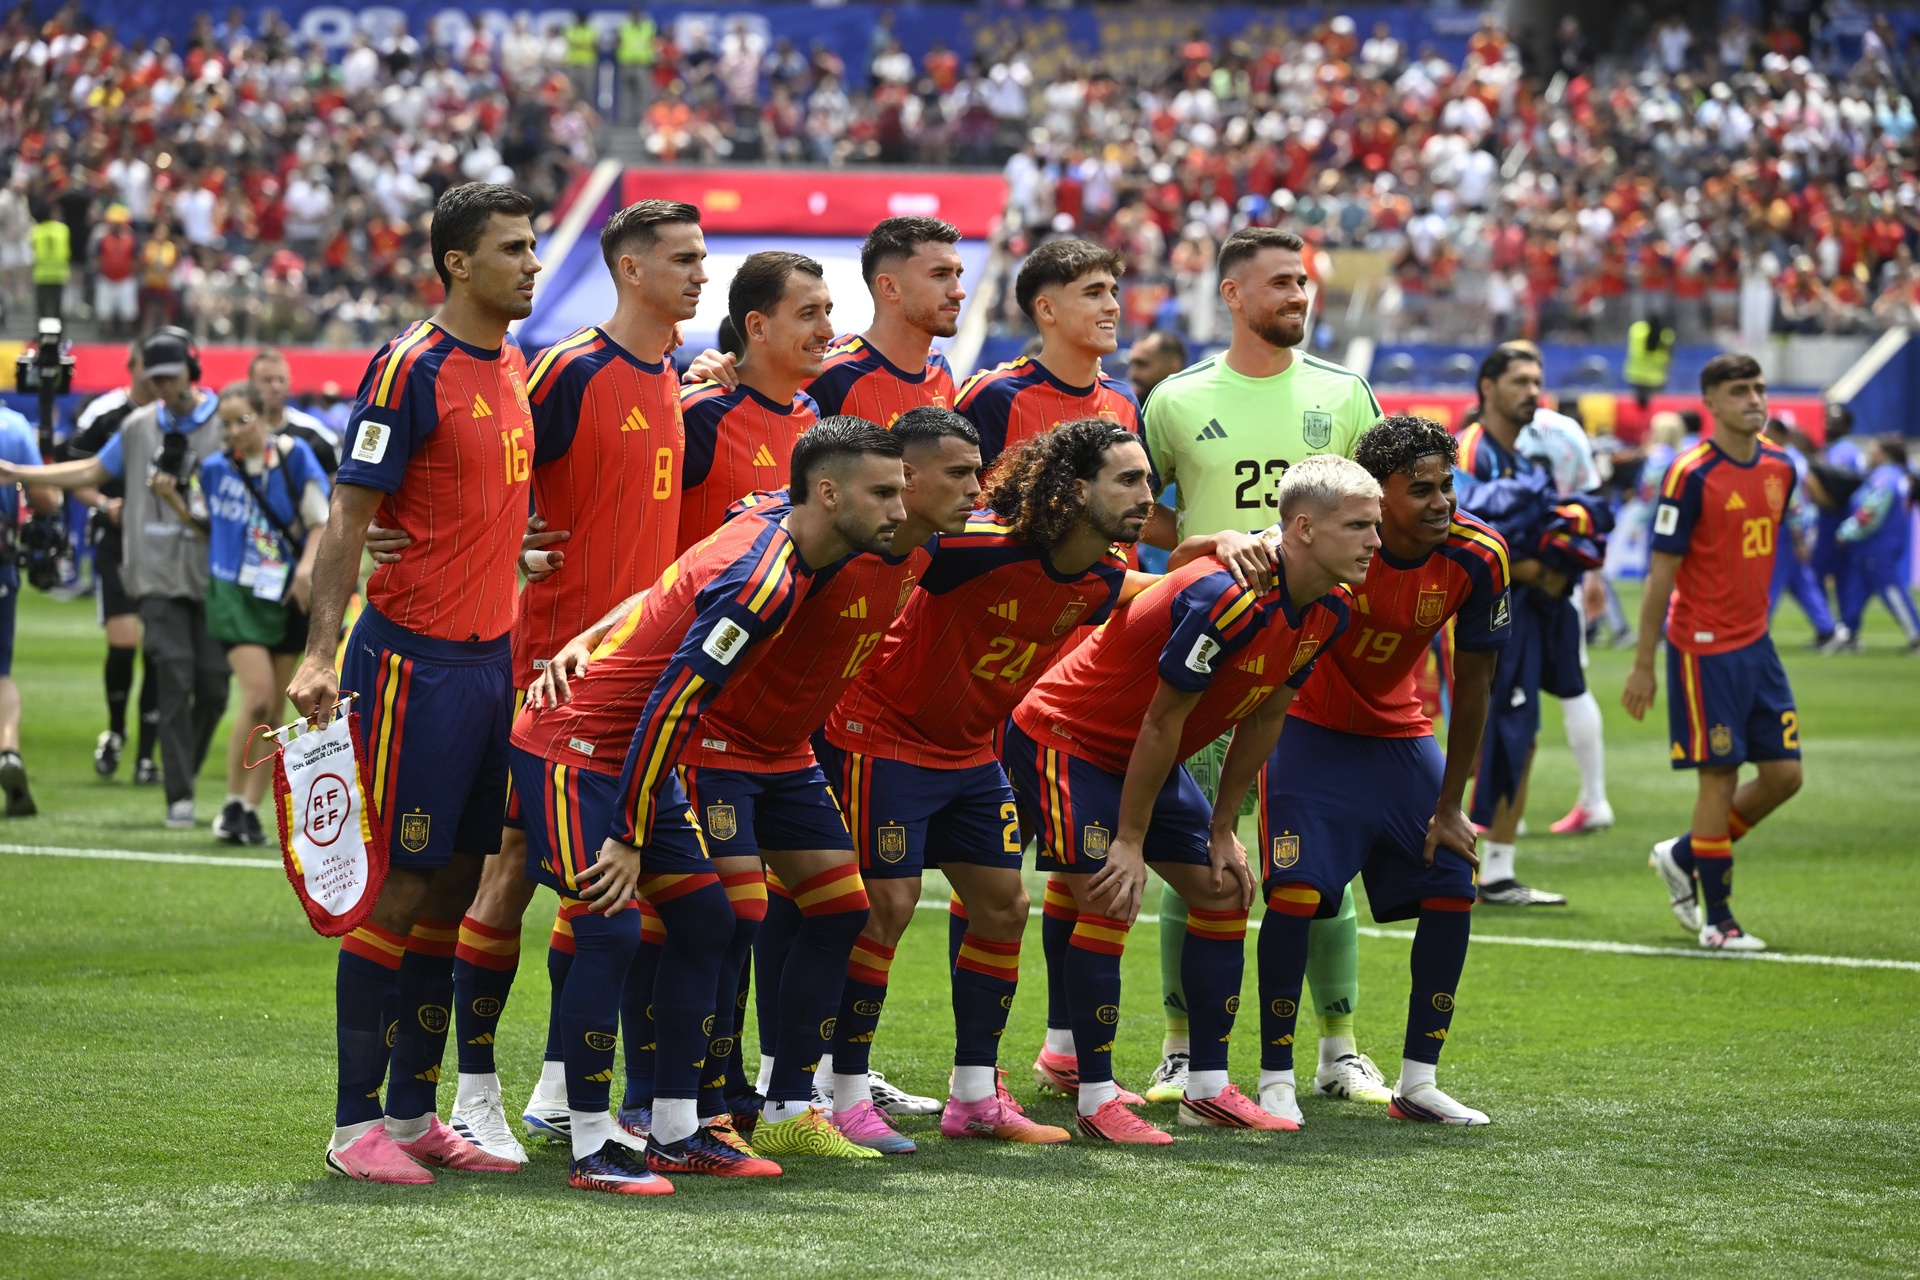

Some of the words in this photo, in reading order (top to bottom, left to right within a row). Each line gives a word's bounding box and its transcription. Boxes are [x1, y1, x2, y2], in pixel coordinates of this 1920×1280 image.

[502, 428, 530, 485] 16
[653, 447, 673, 500] 8
[1742, 517, 1773, 558] 20
[841, 631, 882, 680] 12
[971, 636, 1038, 684] 24
[1352, 628, 1402, 664] 19
[313, 788, 338, 812] RF
[313, 808, 339, 832] EF
[323, 892, 332, 900] DE
